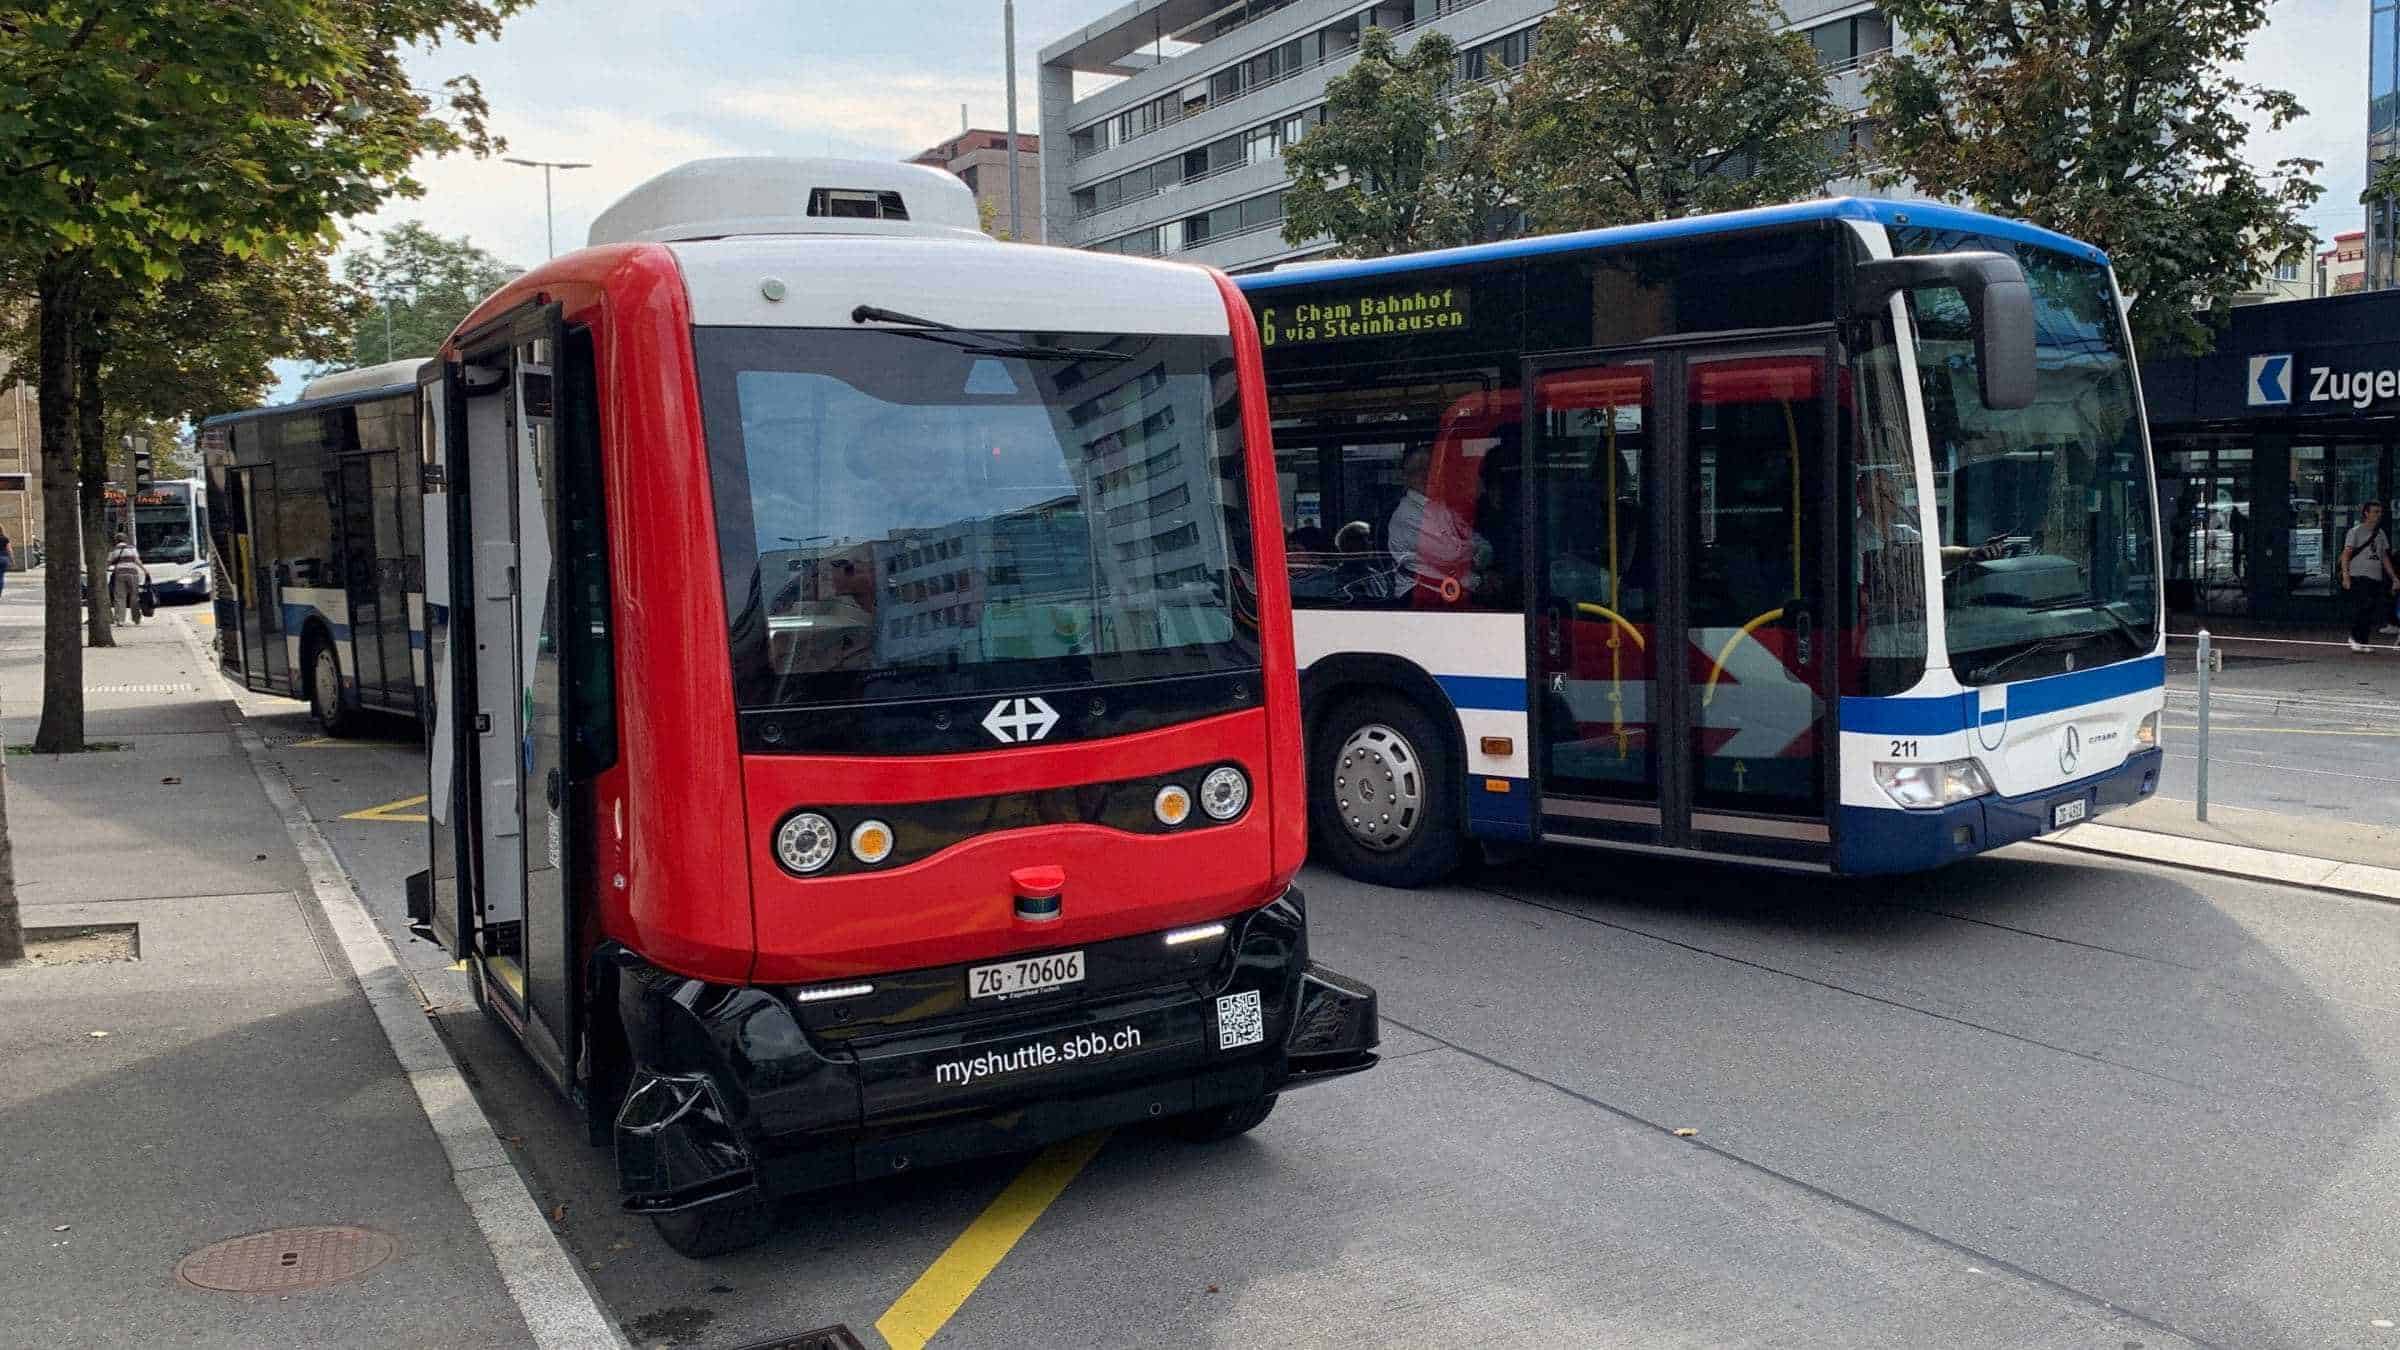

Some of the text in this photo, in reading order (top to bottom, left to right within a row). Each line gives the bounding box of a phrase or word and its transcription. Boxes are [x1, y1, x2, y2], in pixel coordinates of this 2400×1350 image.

[1296, 289, 1453, 322] Cham Bahnhof
[1263, 308, 1276, 346] 6
[1285, 310, 1463, 342] via Steinhausen
[2309, 366, 2400, 409] Zuge
[1890, 740, 1918, 757] 211
[936, 1025, 1142, 1086] myshuttle.sbb.ch
